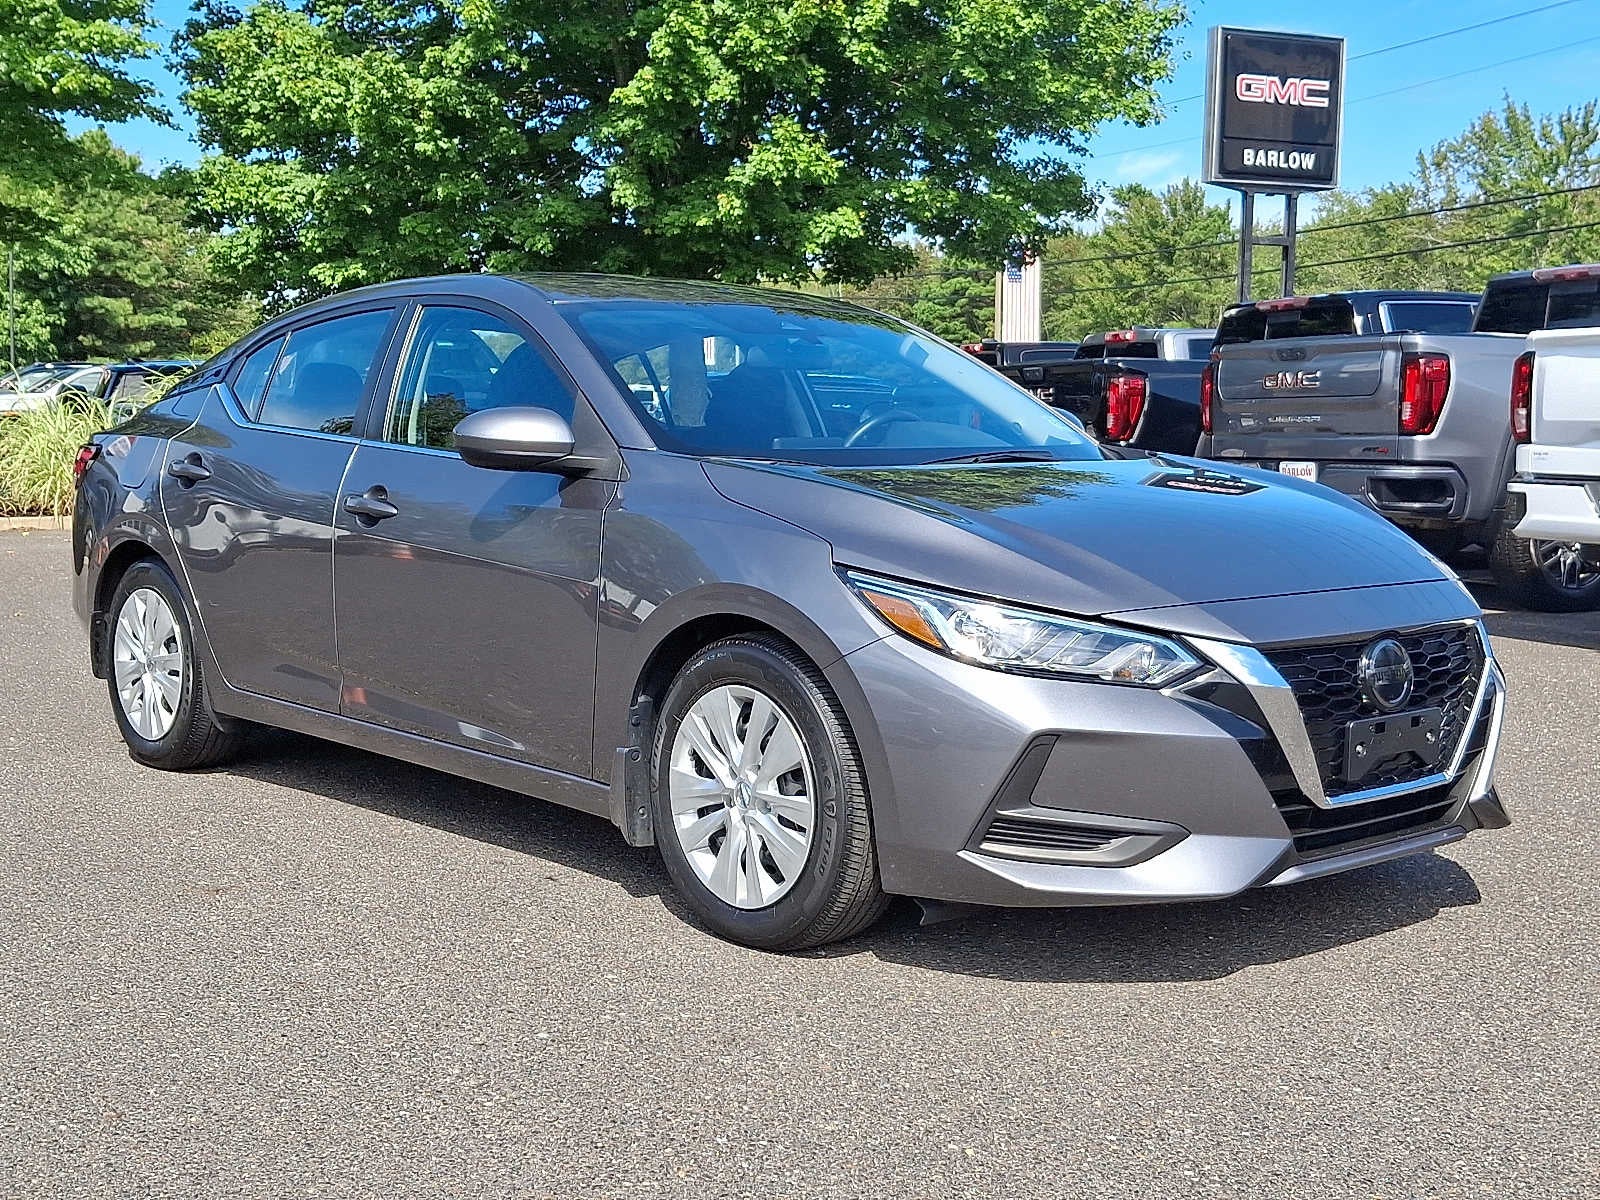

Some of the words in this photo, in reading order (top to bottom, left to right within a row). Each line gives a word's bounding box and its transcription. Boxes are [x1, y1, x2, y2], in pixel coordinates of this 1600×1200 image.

[1236, 73, 1330, 108] GMC
[1243, 148, 1316, 170] BARLOW
[1263, 371, 1321, 389] GMC
[1281, 467, 1313, 477] BARLOW
